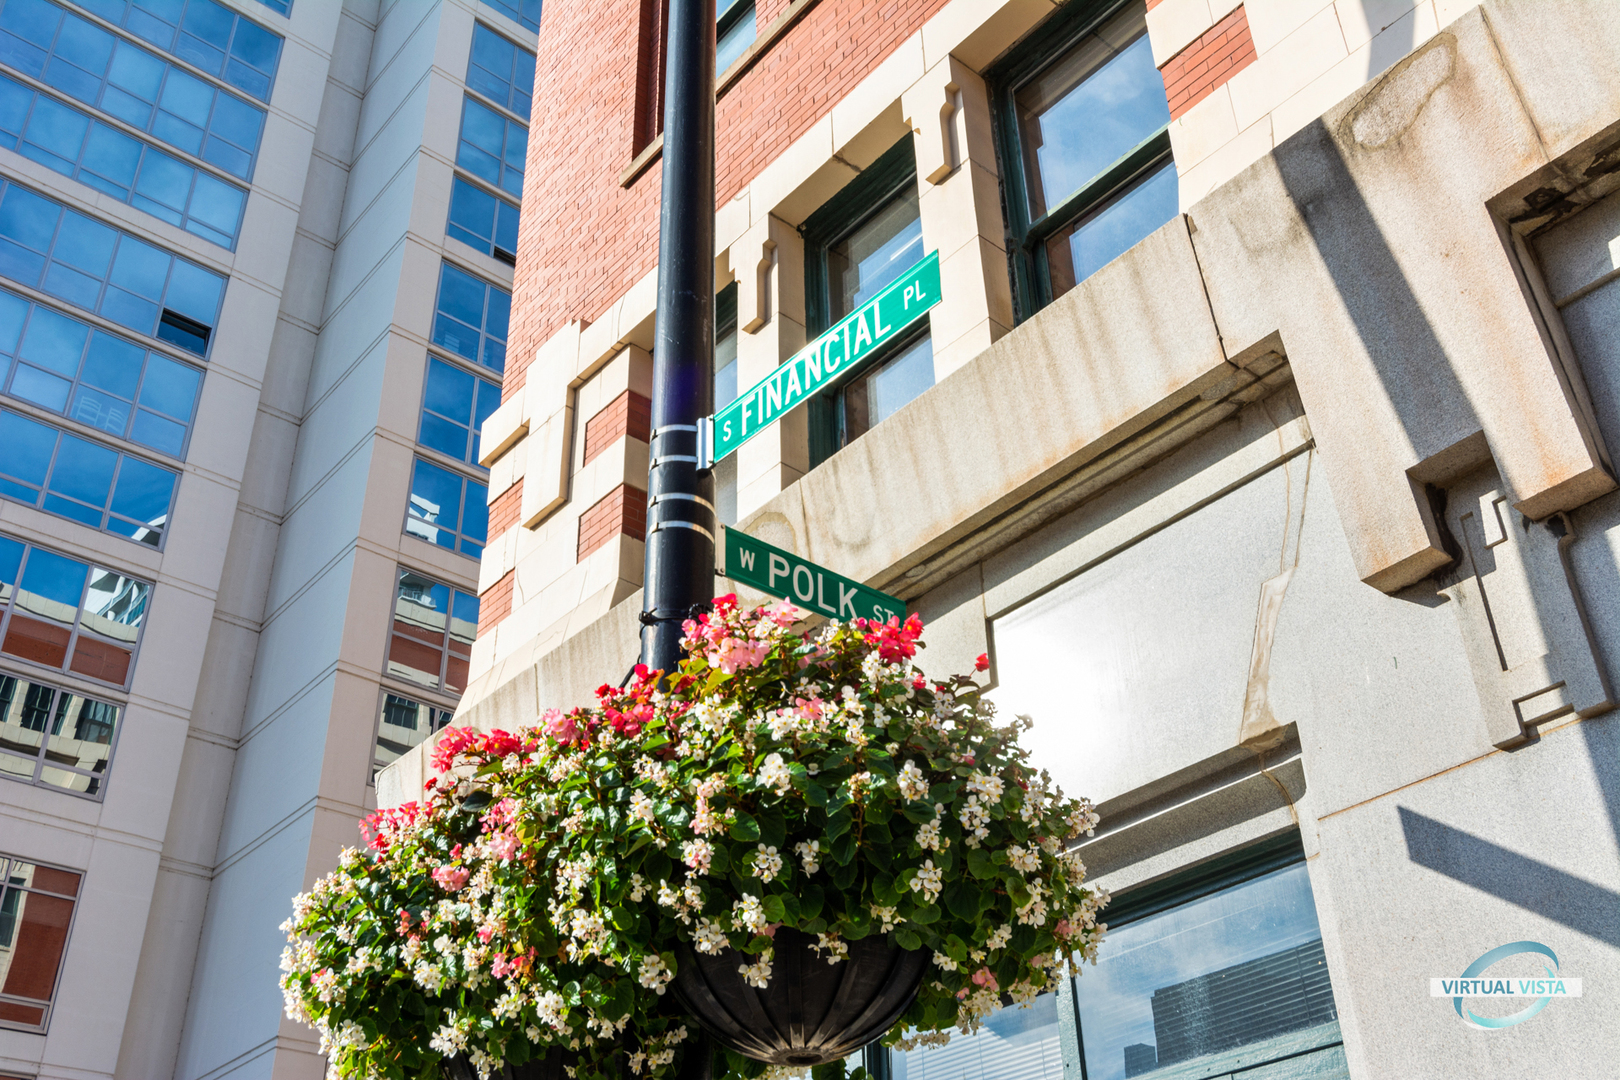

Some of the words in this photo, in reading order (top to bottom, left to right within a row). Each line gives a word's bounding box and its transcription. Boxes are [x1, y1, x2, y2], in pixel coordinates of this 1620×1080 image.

[722, 419, 732, 442] S
[741, 301, 891, 437] FINANCIAL
[903, 279, 926, 311] PL
[739, 546, 756, 572] W
[768, 552, 858, 619] POLK
